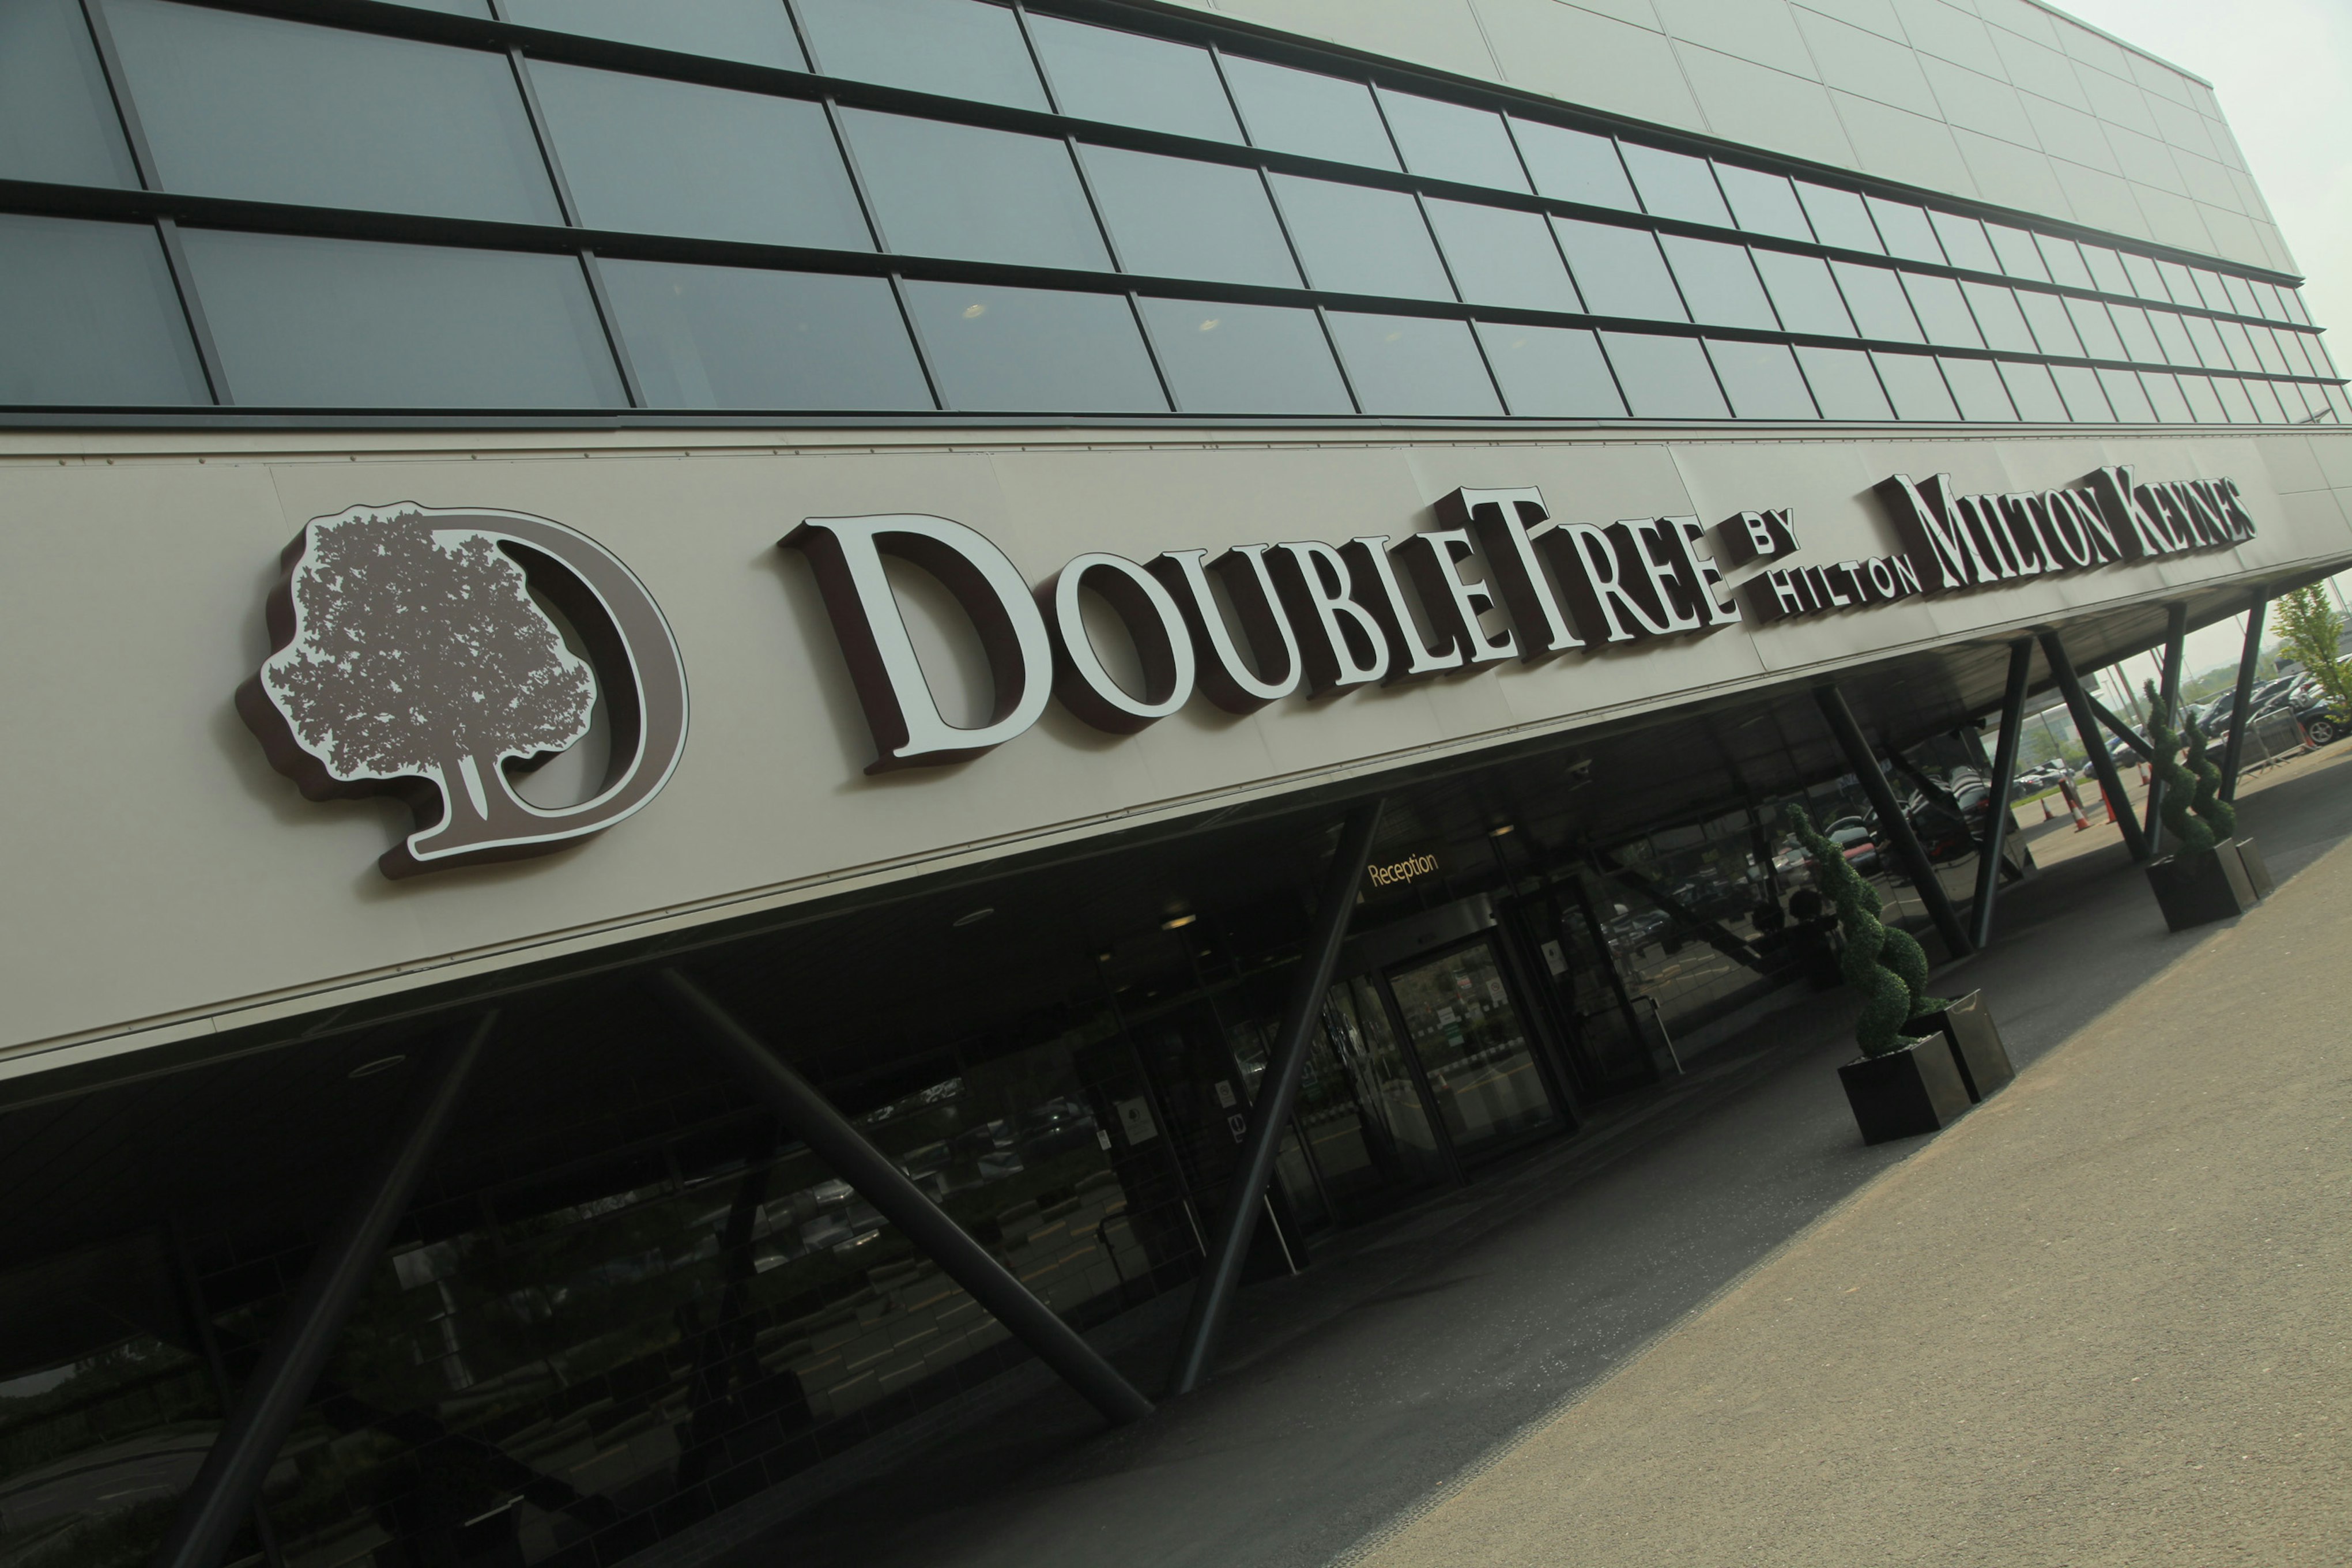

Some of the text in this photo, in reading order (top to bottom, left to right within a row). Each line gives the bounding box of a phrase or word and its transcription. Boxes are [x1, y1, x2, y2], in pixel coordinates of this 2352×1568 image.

[1740, 507, 1801, 555] BY
[1893, 465, 2257, 588] MILTON KEYNES
[1765, 553, 1923, 613] HILTON
[804, 485, 1743, 757] DOUBLETREE
[1367, 853, 1439, 887] Reception
